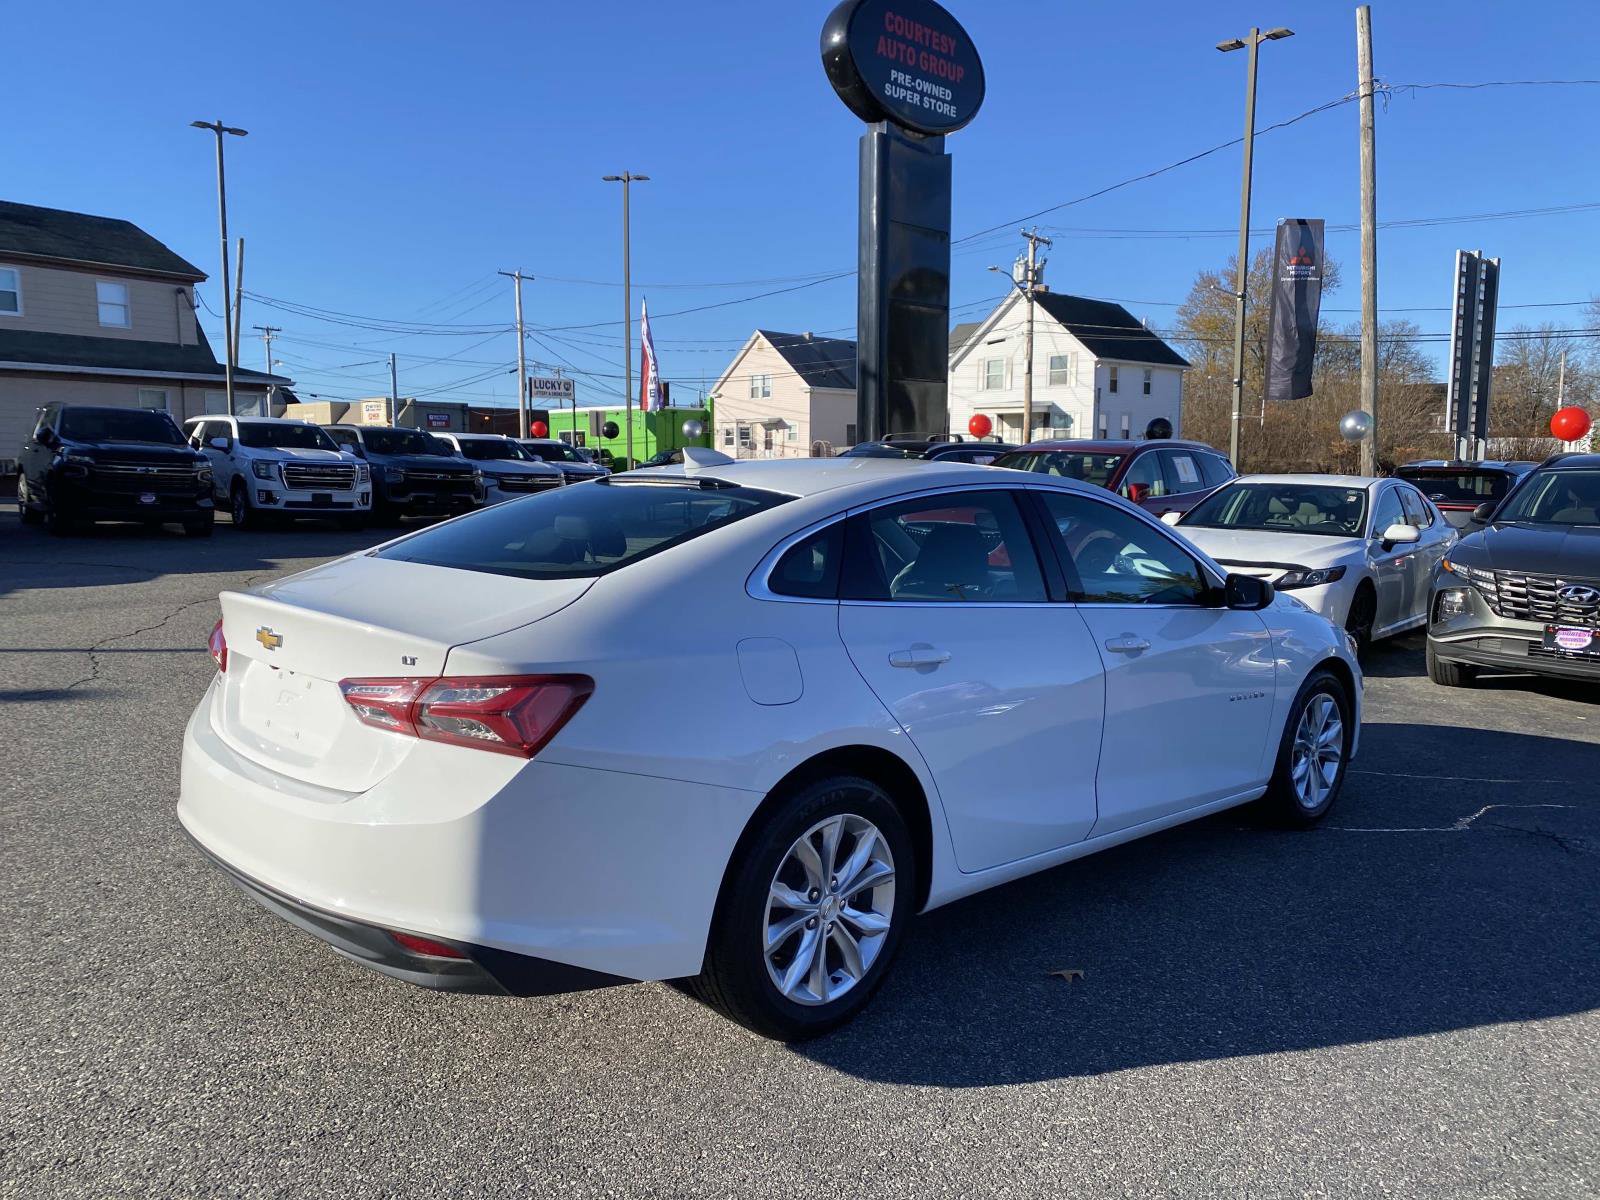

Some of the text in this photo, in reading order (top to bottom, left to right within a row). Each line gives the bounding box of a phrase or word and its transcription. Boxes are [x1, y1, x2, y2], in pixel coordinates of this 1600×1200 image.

[884, 12, 957, 57] COURTESY
[877, 36, 965, 83] AUTO GROUP
[884, 83, 957, 118] SUPER STORE
[890, 69, 952, 101] PRE-OWNED
[534, 379, 562, 391] LUCKY
